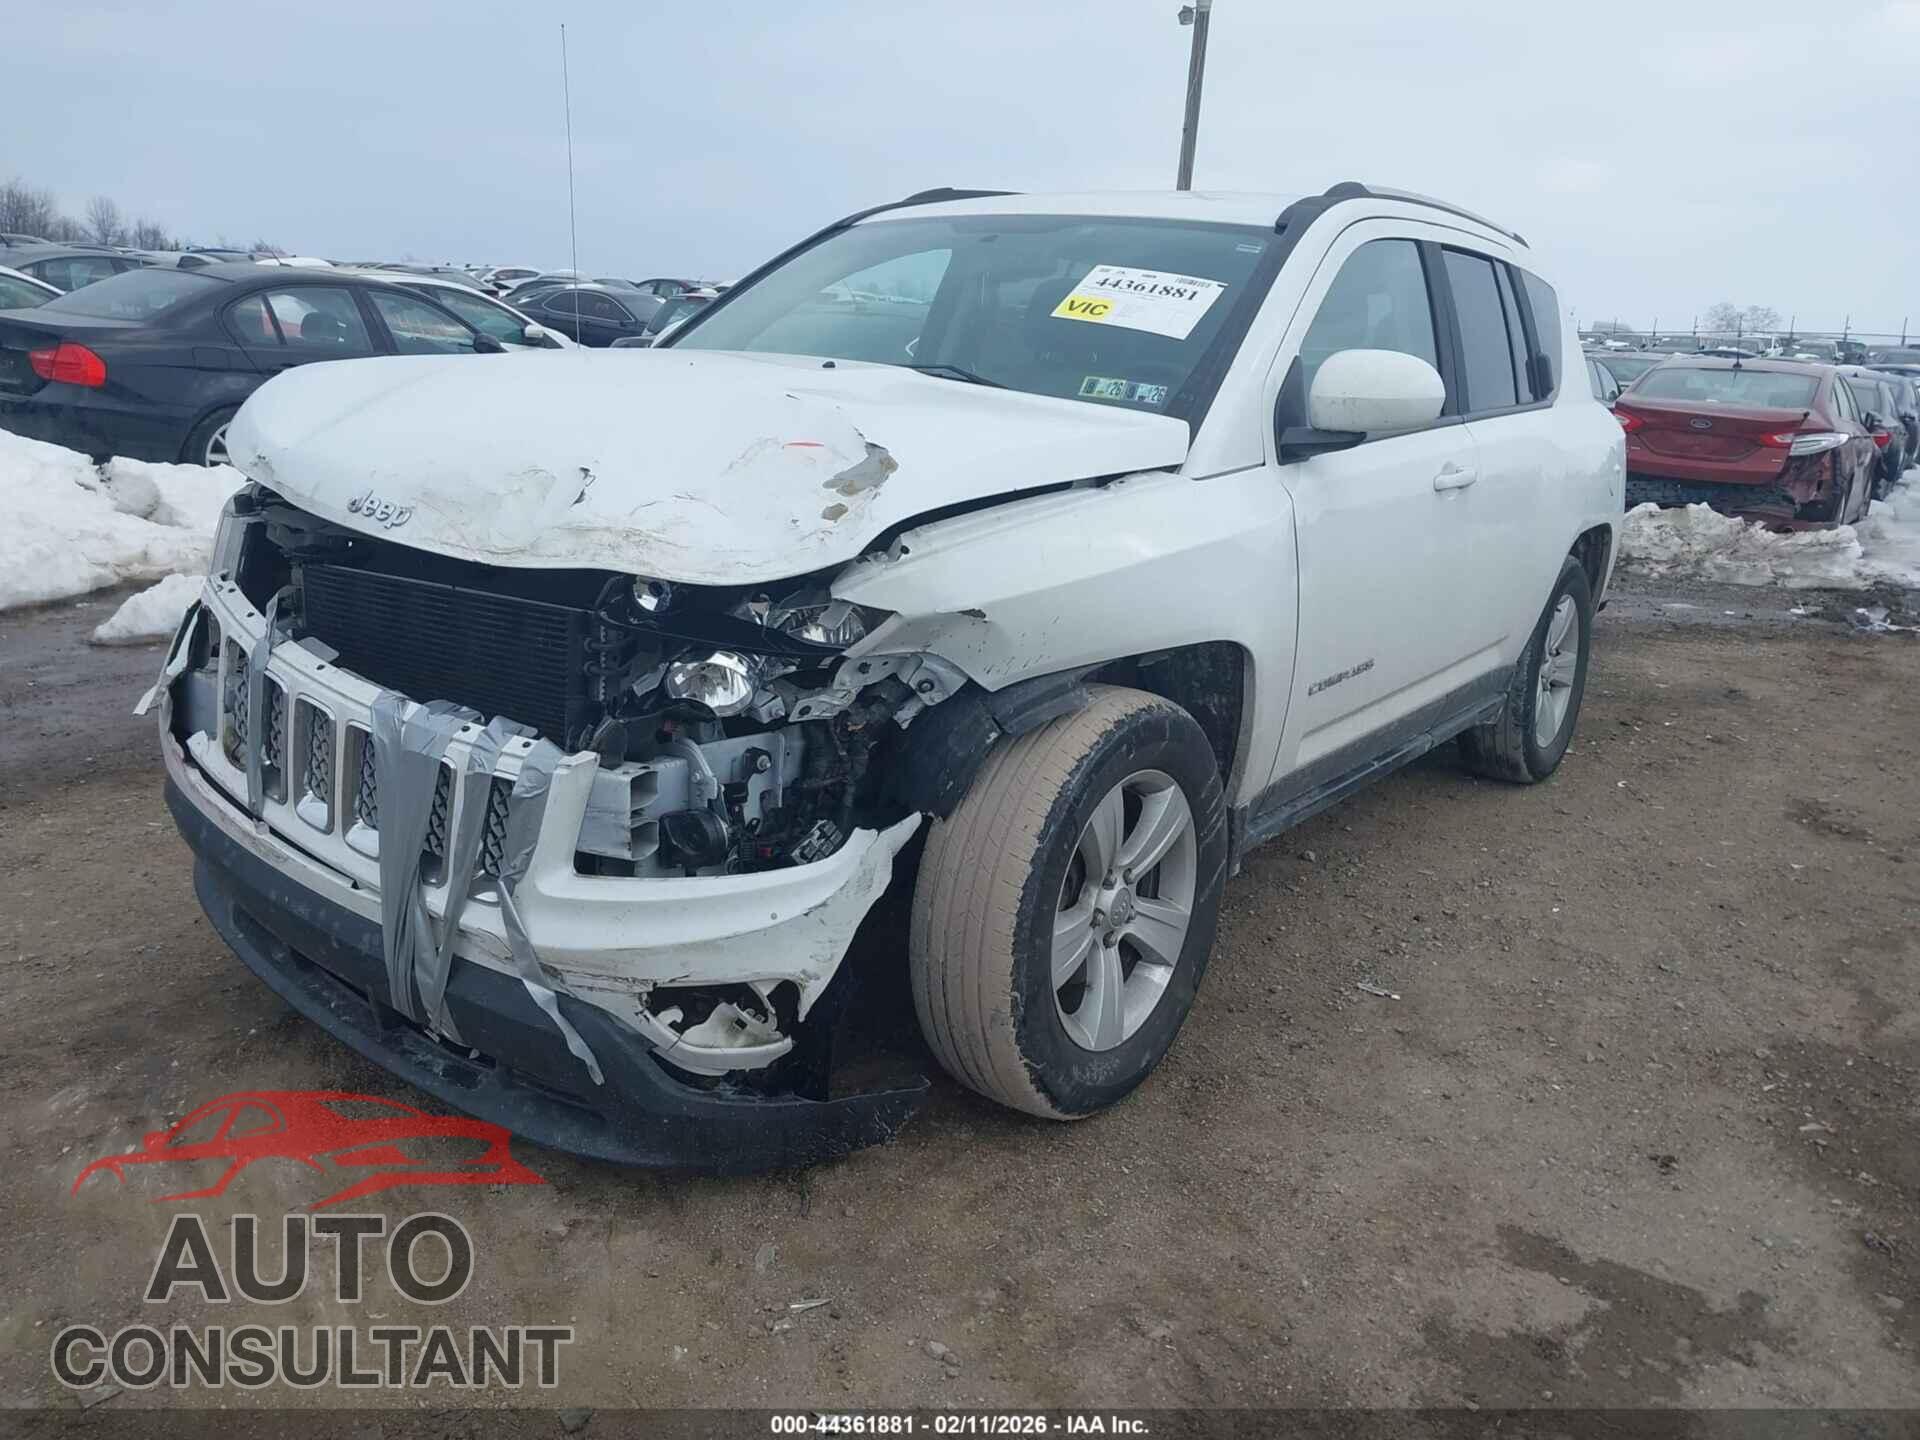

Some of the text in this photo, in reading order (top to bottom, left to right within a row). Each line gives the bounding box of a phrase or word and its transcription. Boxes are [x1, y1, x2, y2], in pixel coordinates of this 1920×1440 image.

[1096, 277, 1199, 301] 44361881
[1067, 299, 1109, 317] VIC
[347, 489, 412, 530] Jeep
